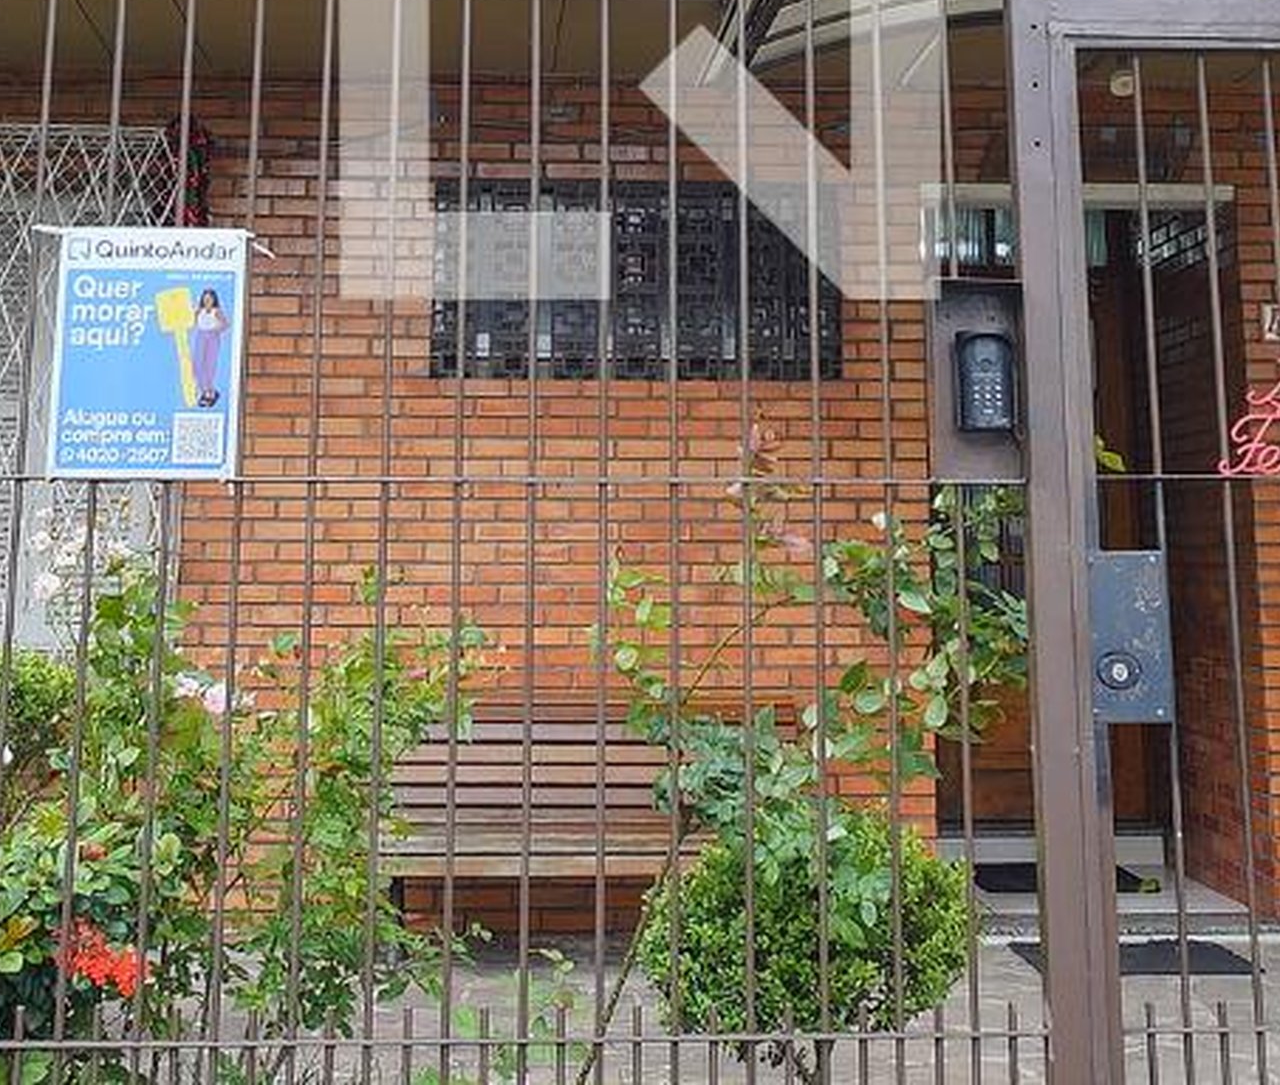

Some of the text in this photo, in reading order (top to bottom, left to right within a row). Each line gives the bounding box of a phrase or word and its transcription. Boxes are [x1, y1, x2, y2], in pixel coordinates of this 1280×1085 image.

[95, 239, 237, 261] QuintoAndar
[73, 274, 145, 299] Quer
[71, 302, 156, 323] morar
[70, 321, 146, 348] aqui?
[62, 408, 157, 430] Alugue ou
[60, 428, 171, 447] compre em:
